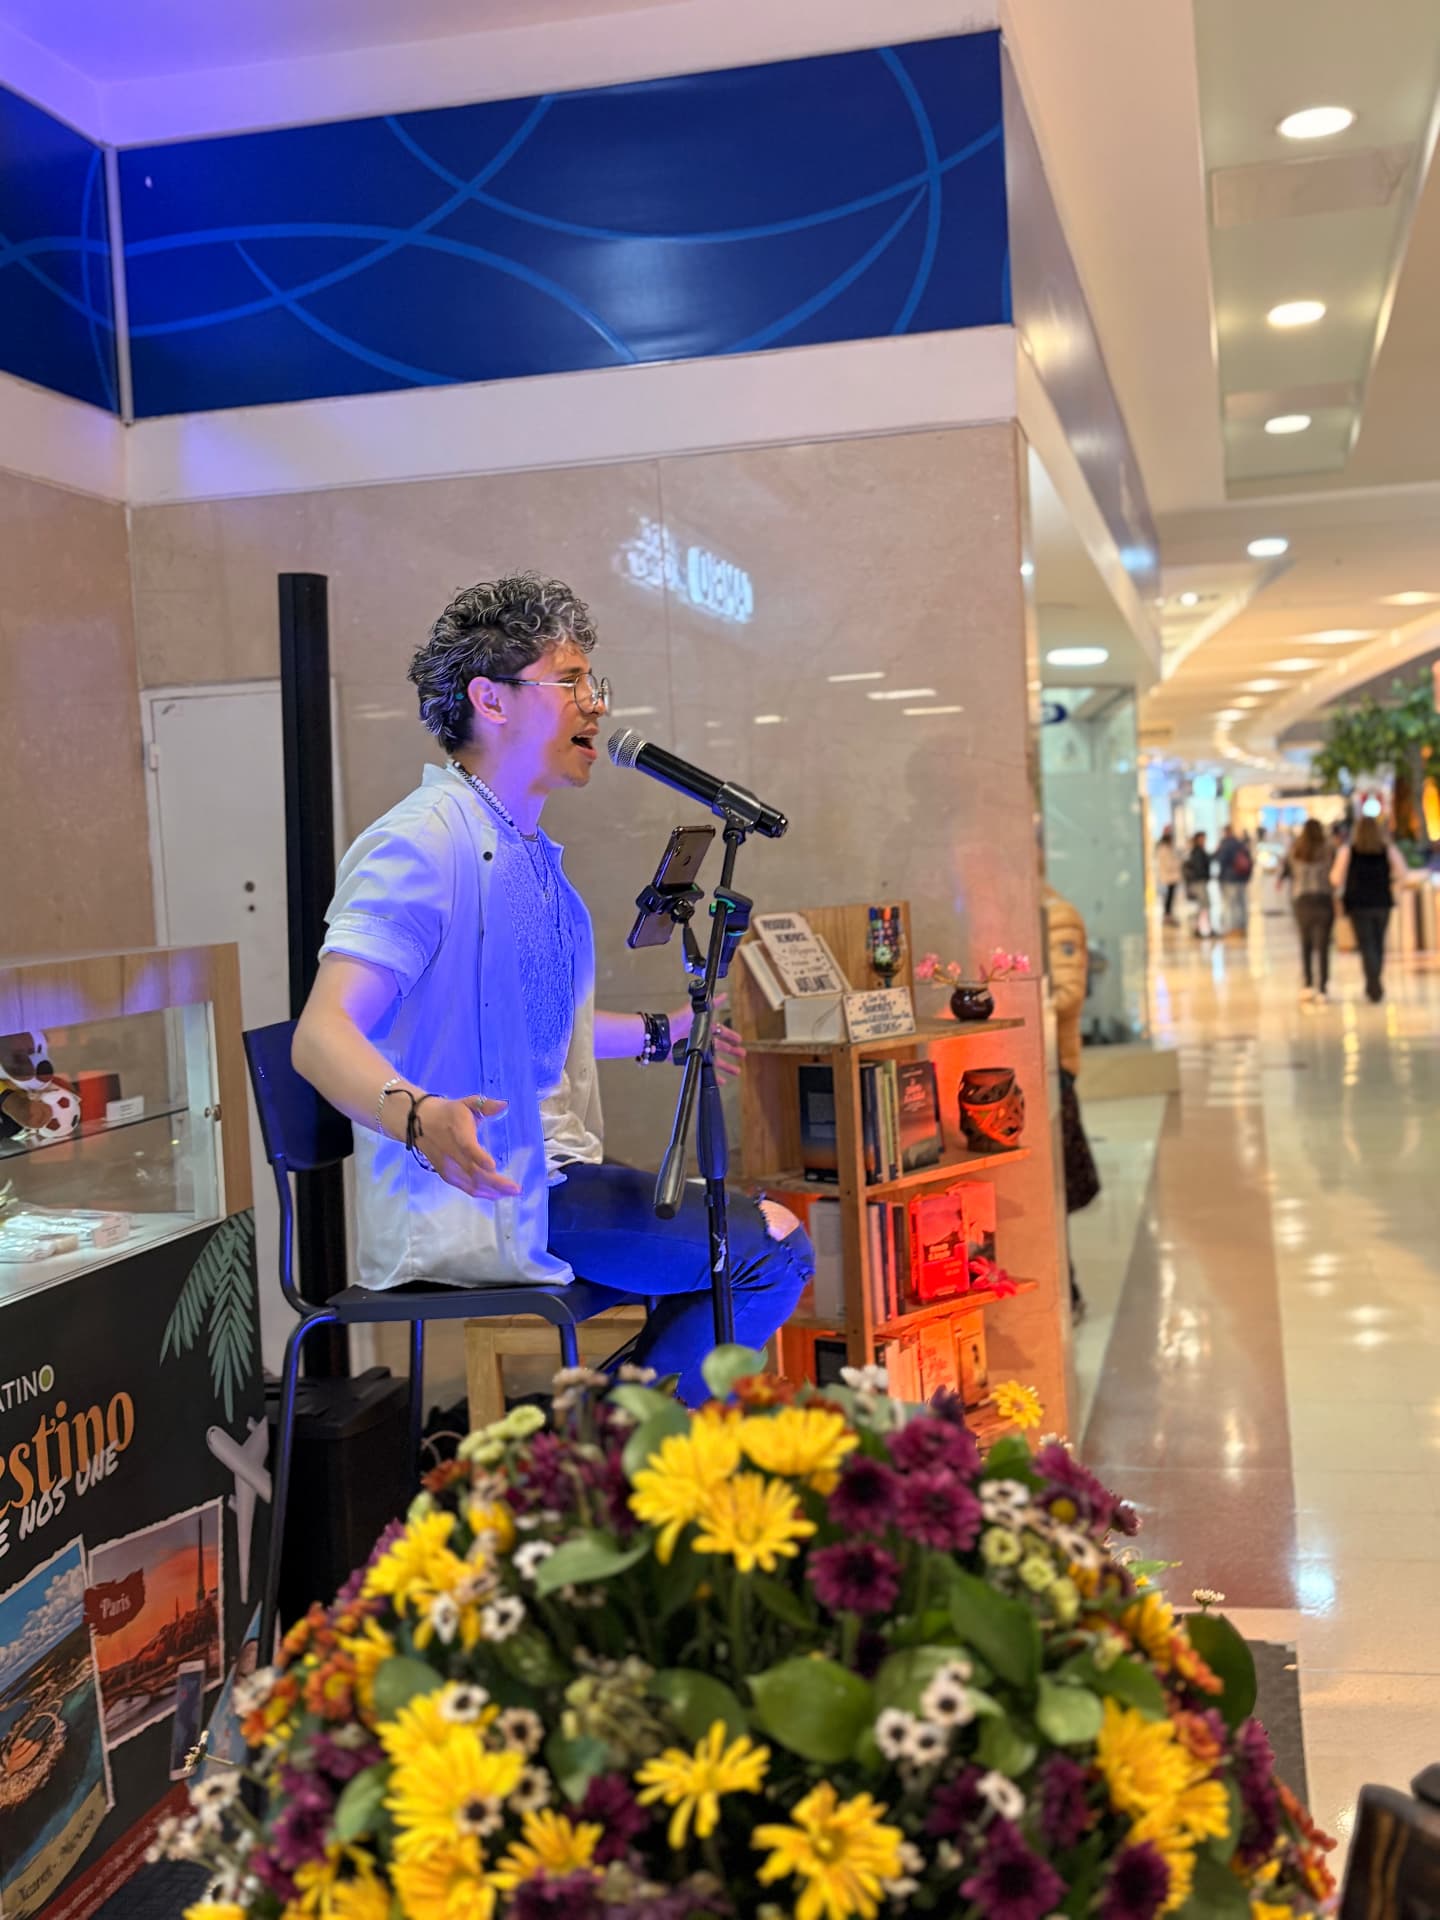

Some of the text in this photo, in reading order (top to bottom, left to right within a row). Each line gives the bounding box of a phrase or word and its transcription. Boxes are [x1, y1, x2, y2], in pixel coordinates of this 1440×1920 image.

[19, 1476, 68, 1541] NOS
[75, 1440, 119, 1496] UNE
[99, 1592, 132, 1619] Paris
